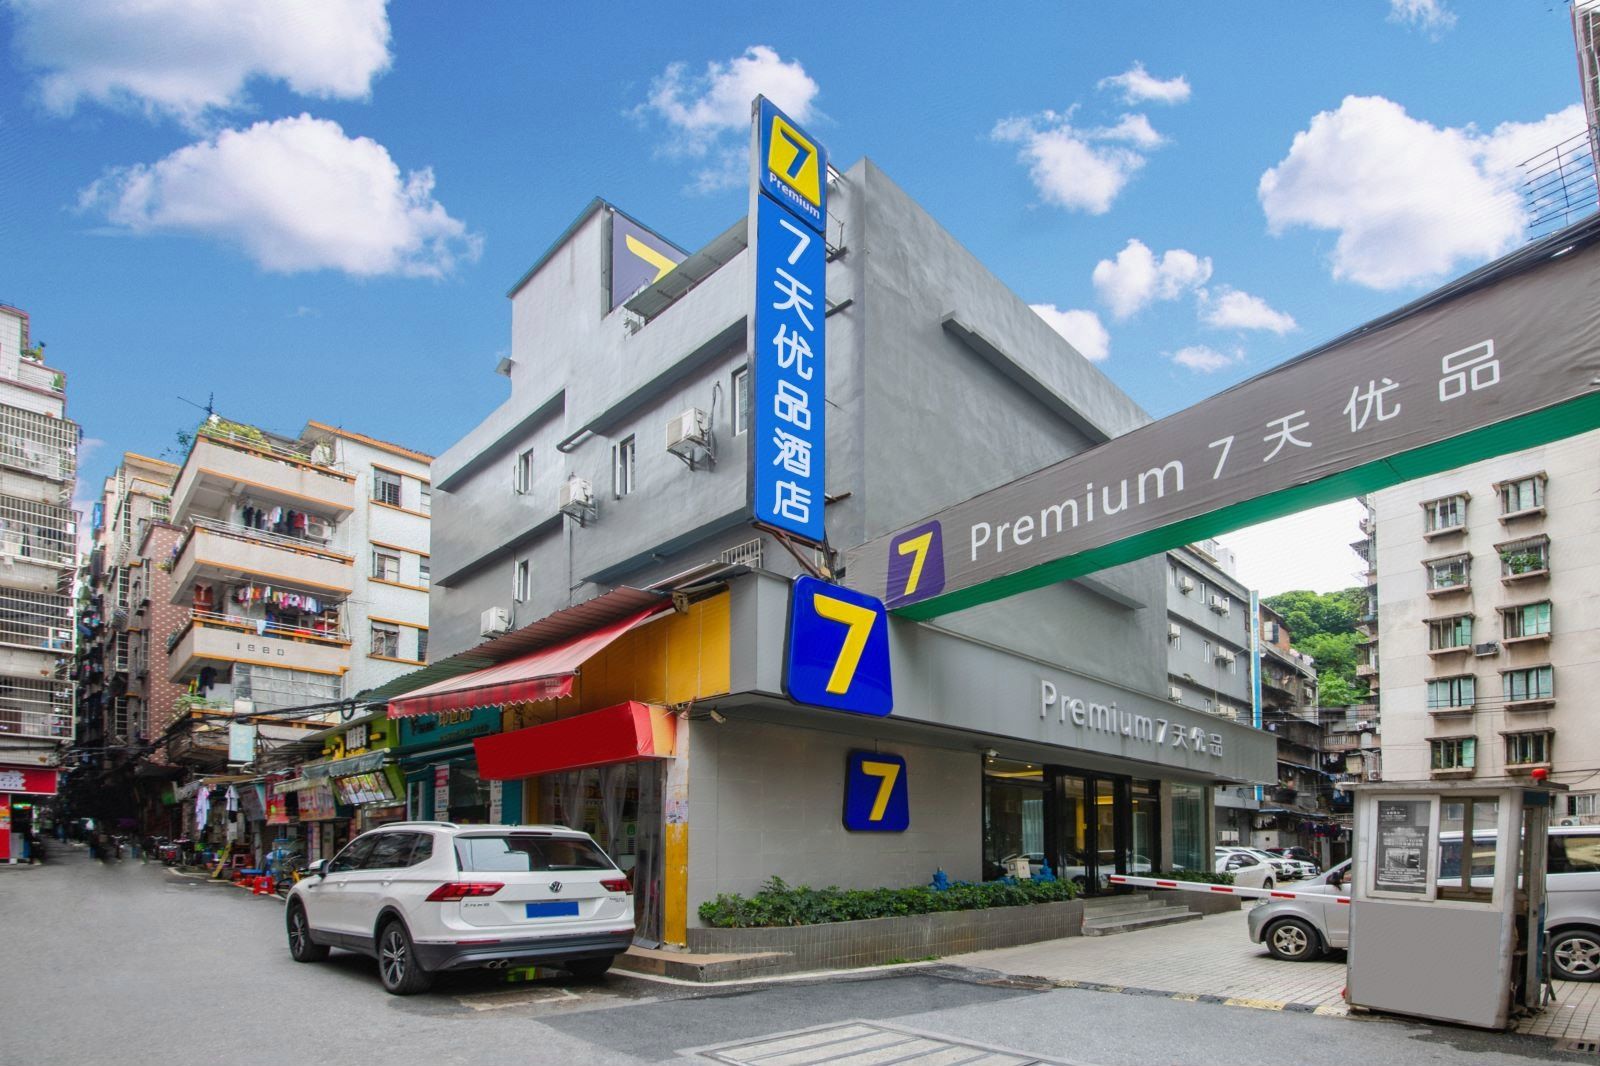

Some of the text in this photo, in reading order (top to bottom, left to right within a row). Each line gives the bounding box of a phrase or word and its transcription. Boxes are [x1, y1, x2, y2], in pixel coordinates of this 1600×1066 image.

[769, 171, 820, 220] Premium
[772, 218, 816, 524] 7天优品酒店
[970, 338, 1501, 562] Premium 7天优品
[897, 531, 935, 596] 7
[813, 592, 878, 695] 7
[1039, 679, 1153, 743] Premium
[861, 760, 901, 822] 7
